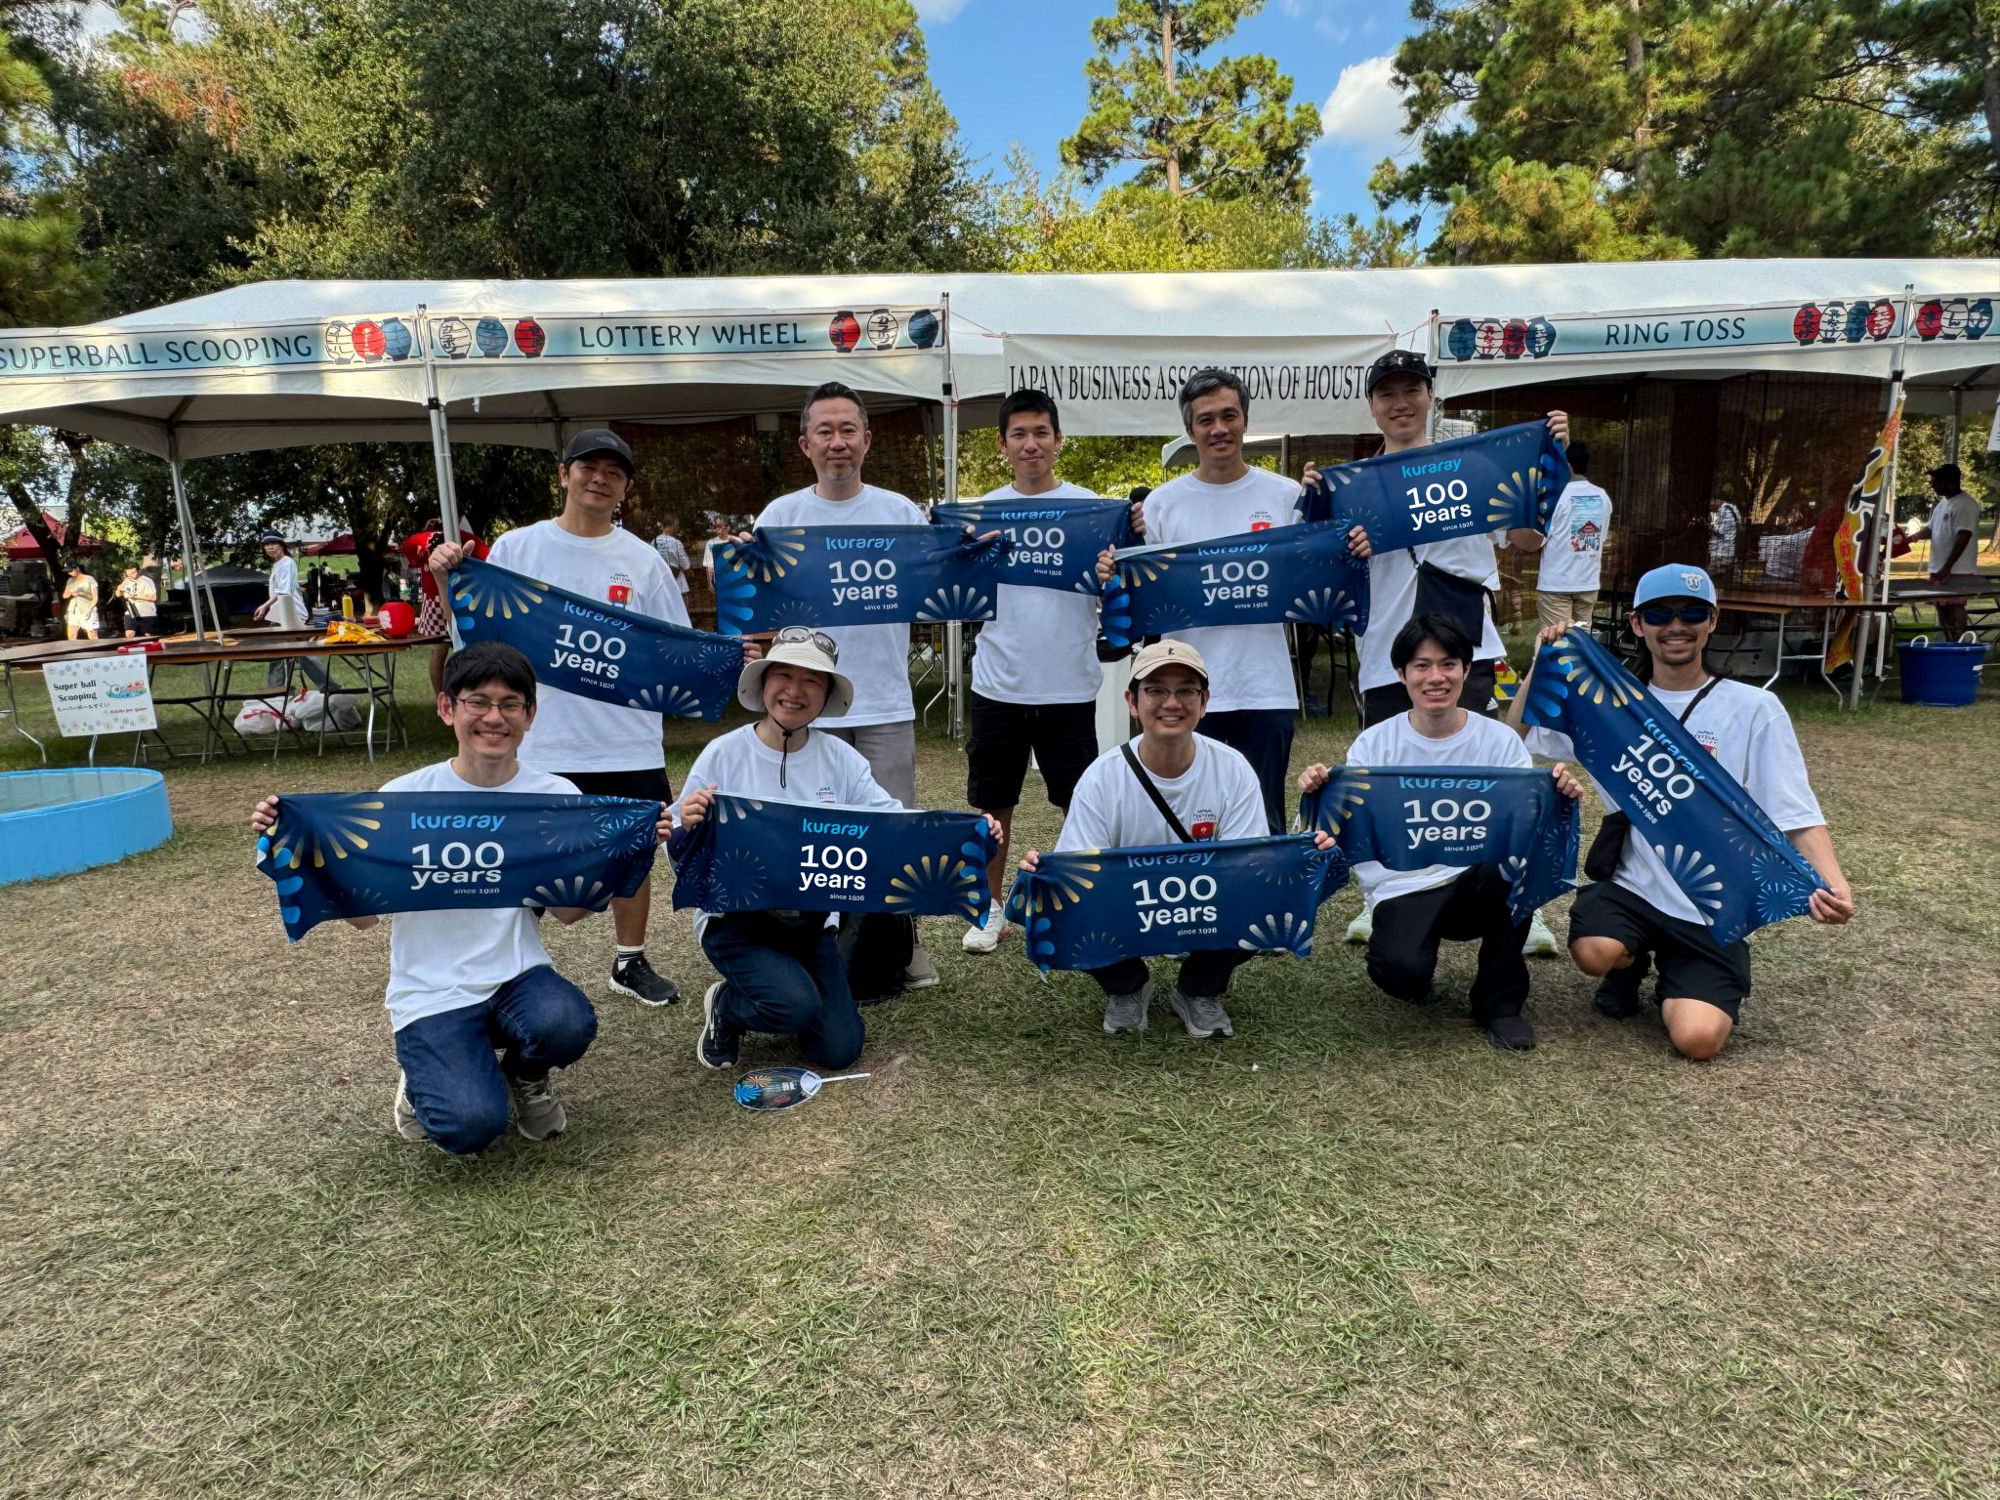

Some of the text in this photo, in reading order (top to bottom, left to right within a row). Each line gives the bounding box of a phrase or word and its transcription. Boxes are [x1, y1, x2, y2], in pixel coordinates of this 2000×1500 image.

[579, 324, 701, 348] LOTTERY
[711, 322, 807, 345] WHEEL
[1604, 317, 1746, 346] RING TOSS
[0, 342, 158, 371] SUPERBALL
[165, 335, 312, 363] SCOOPING
[1009, 364, 1064, 401] JAPAN
[1068, 365, 1151, 401] BUSINESS
[1278, 365, 1301, 401] OF
[1401, 457, 1462, 479] kuraray
[1406, 479, 1468, 509] 100
[1000, 510, 1066, 521] kuraray
[1411, 502, 1472, 531] years
[1442, 523, 1458, 532] since
[825, 536, 896, 551] kuraray
[1004, 527, 1065, 549] 100
[1007, 549, 1064, 568] years
[828, 559, 897, 584] 100
[1200, 560, 1270, 586] 100
[832, 583, 898, 607] years
[1203, 583, 1269, 607] years
[564, 600, 634, 631] kuraray
[555, 624, 627, 660] 100
[550, 648, 620, 679] years
[53, 680, 97, 691] Super ball
[580, 676, 598, 686] since
[58, 692, 98, 702] Scooping
[1643, 717, 1707, 781] kuraray
[1627, 733, 1695, 800] 100
[1399, 776, 1498, 793] kuraray
[1610, 753, 1673, 816] years
[410, 812, 506, 832] kuraray
[1403, 799, 1491, 823] 100
[802, 818, 869, 839] kuraray
[1407, 825, 1487, 850] years
[411, 841, 505, 869] 100
[800, 843, 868, 871] 100
[1127, 851, 1216, 868] kuraray
[410, 869, 502, 891] years
[798, 871, 866, 891] years
[1132, 874, 1217, 906] 100
[1137, 905, 1217, 932] years
